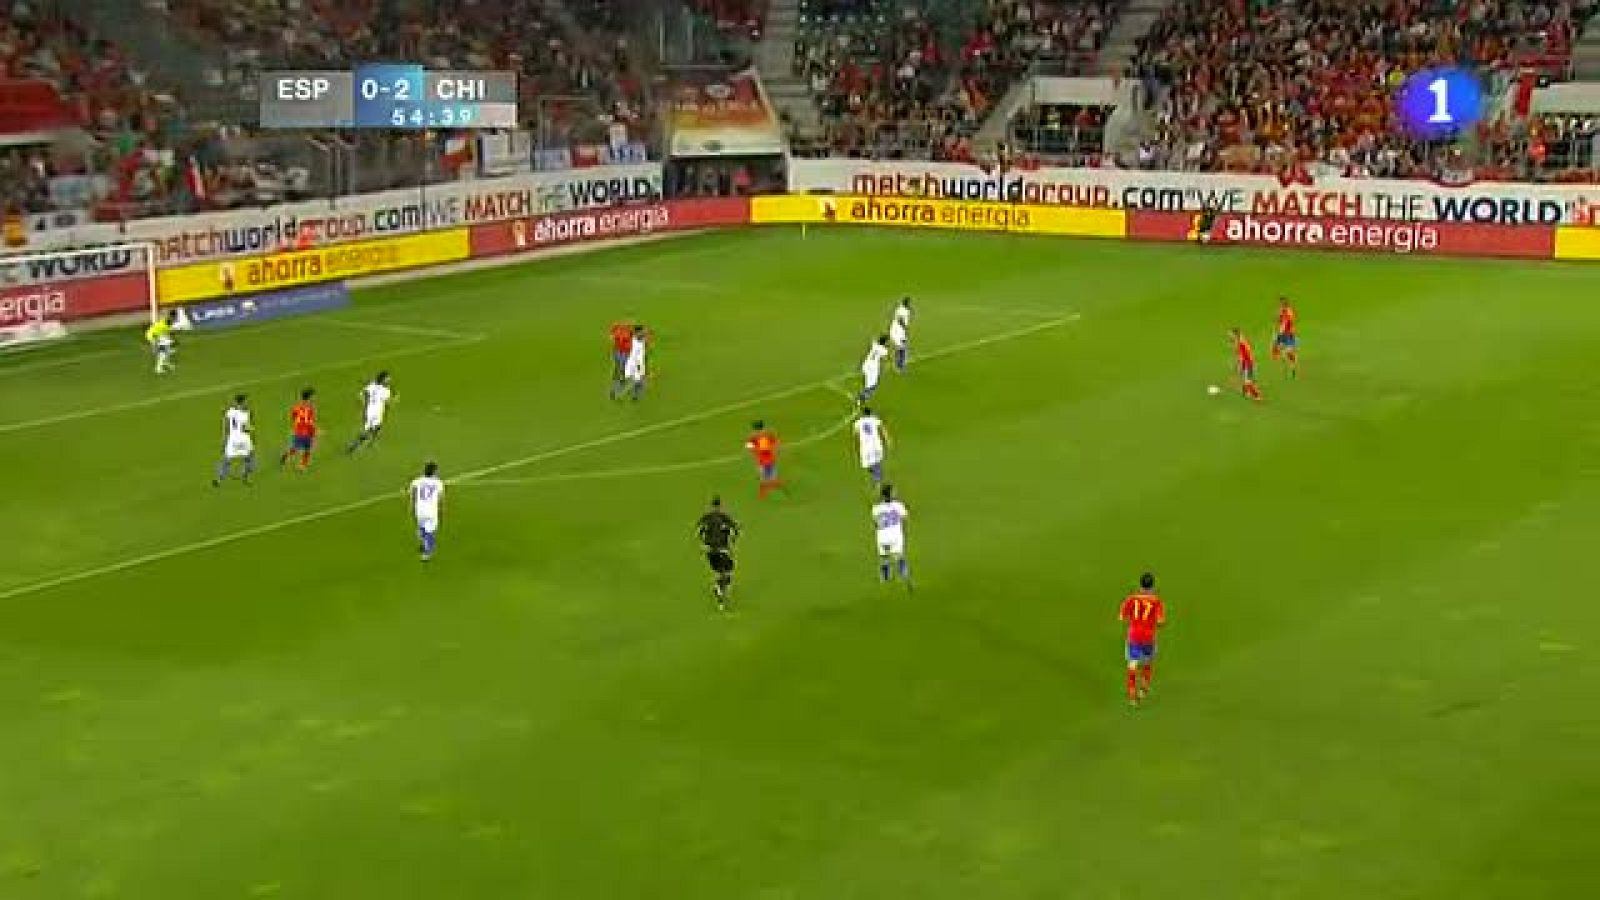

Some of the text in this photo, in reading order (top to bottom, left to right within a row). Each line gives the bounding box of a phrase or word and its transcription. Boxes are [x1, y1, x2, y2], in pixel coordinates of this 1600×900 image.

[464, 185, 532, 221] MATCH
[851, 197, 936, 221] ahorra
[1253, 190, 1362, 216] MATCH
[1372, 194, 1423, 220] THE
[533, 215, 596, 241] ahorra
[1227, 216, 1324, 243] ahorra
[247, 254, 321, 285] ahorra
[1133, 599, 1154, 621] 17
